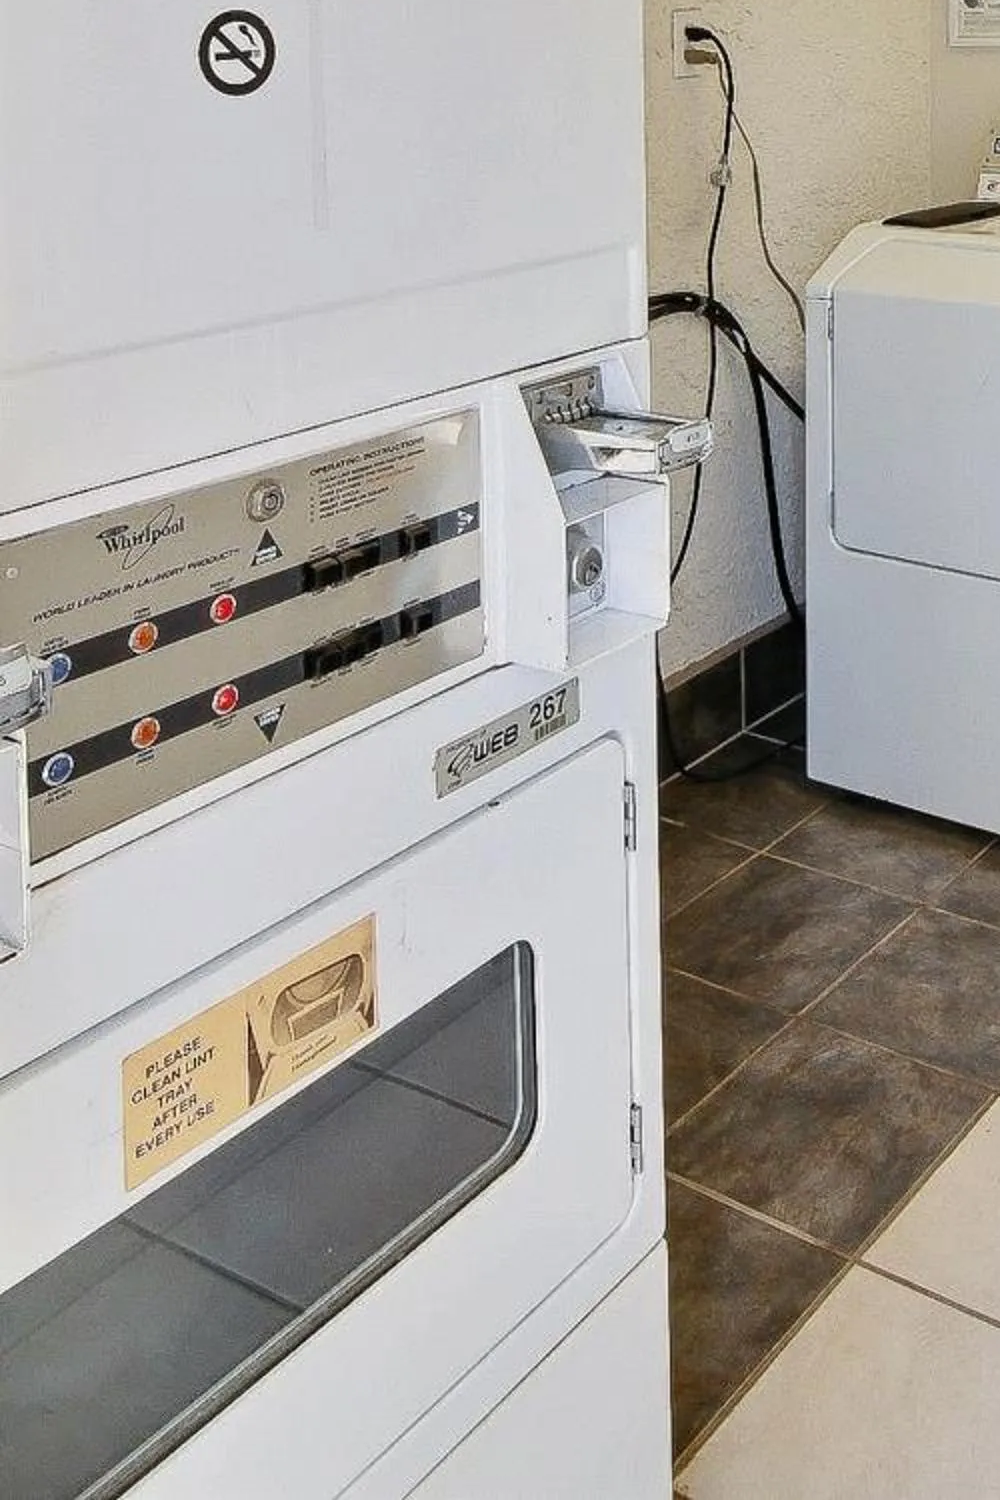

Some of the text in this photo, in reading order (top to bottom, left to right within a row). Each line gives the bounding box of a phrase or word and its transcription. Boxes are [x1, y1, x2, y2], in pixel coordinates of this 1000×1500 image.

[103, 516, 185, 553] Whirlpool
[122, 582, 135, 594] IN
[474, 687, 567, 762] WEB 267
[131, 1046, 215, 1105] CLEAN LINT
[145, 1036, 201, 1079] PLEASE
[152, 1093, 198, 1130] AFTER
[158, 1078, 192, 1109] TRAY
[135, 1101, 215, 1159] EVERY USE
